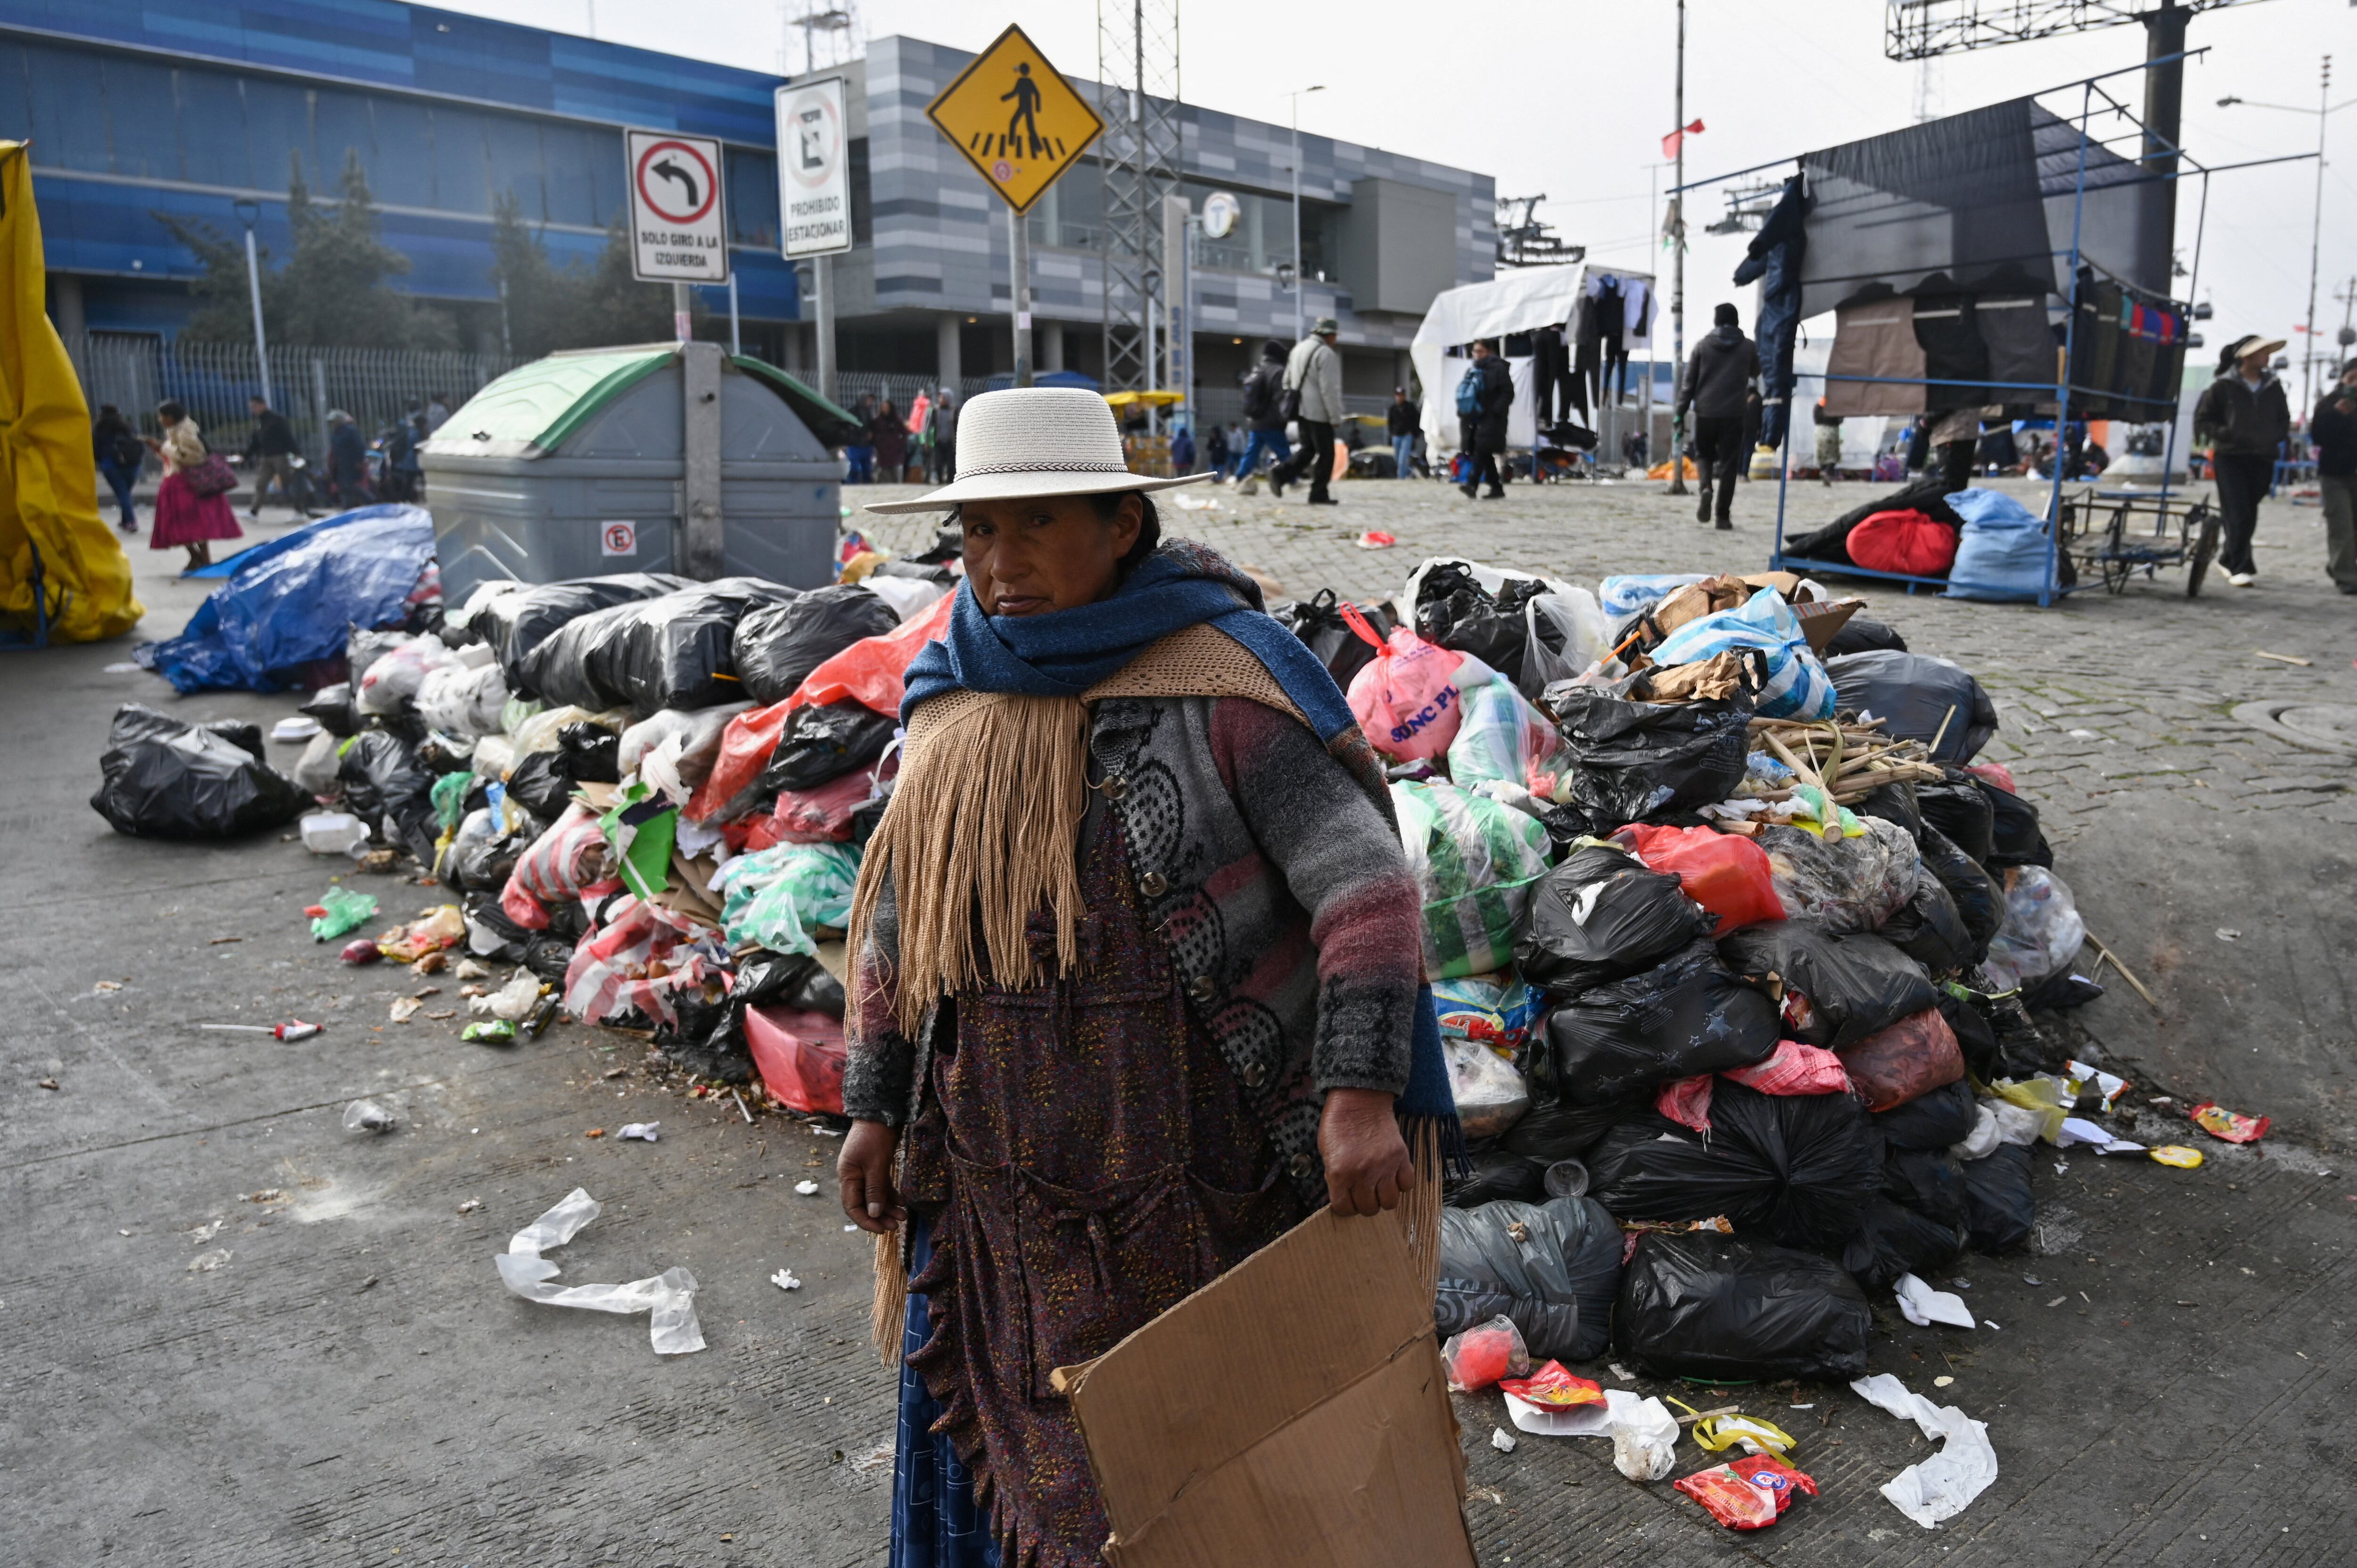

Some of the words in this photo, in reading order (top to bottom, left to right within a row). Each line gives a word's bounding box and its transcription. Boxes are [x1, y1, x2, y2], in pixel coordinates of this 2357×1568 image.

[791, 196, 840, 218] PROHIBIDO
[642, 230, 668, 245] SOLO
[671, 233, 694, 246] GIRO
[697, 236, 704, 247] A
[707, 237, 718, 248] LA
[788, 220, 845, 242] ESTACIONAR
[656, 252, 708, 267] IZQUIERDA
